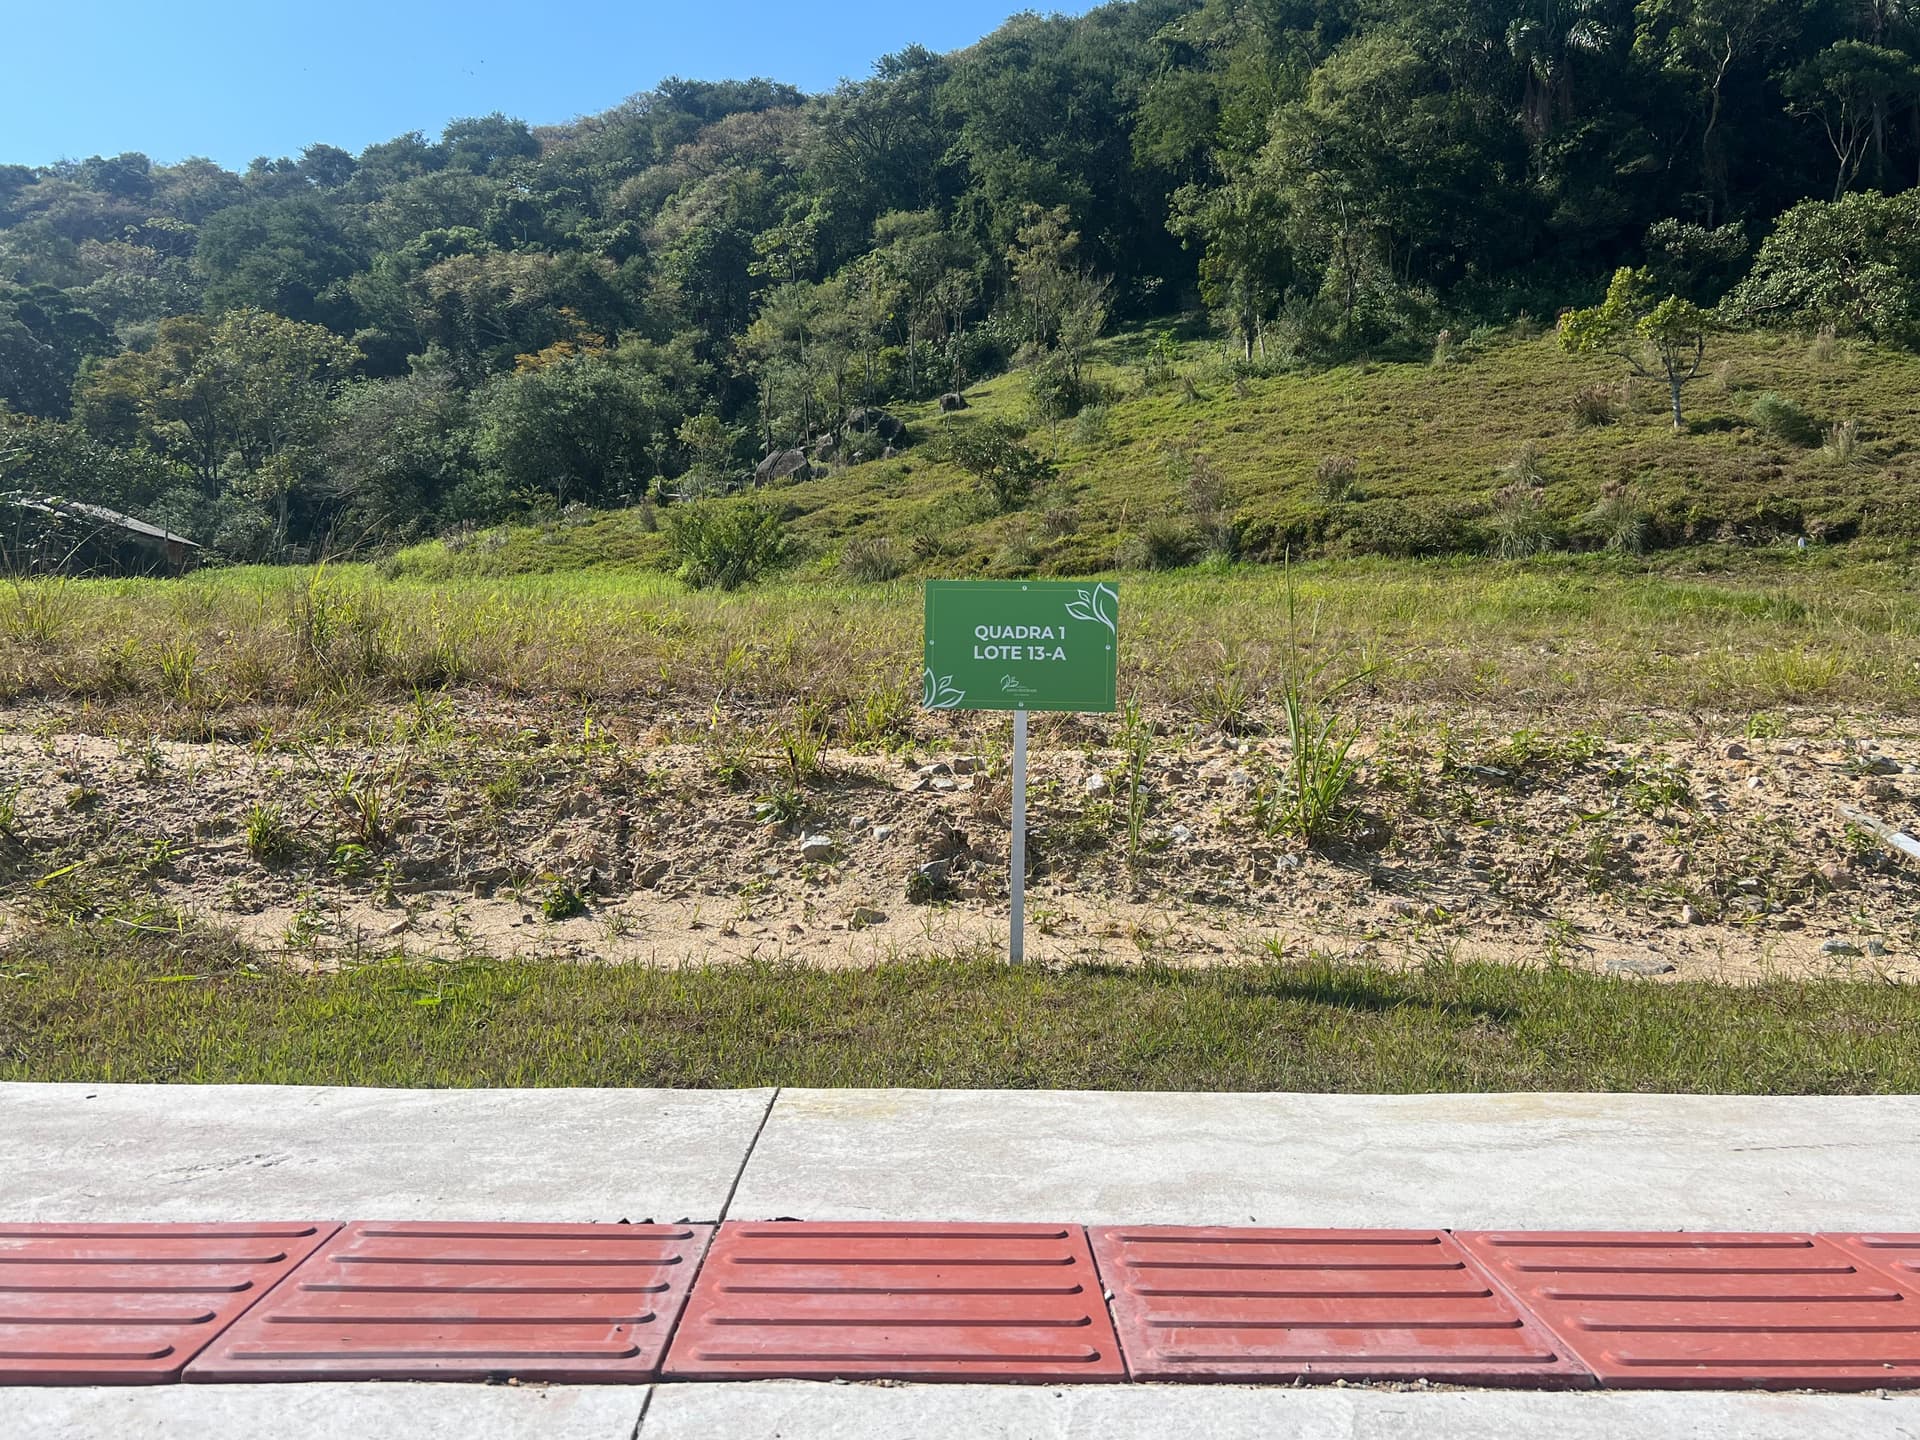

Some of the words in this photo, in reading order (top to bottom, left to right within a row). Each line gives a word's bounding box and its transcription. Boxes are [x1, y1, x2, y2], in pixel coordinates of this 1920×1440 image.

[974, 625, 1054, 641] QUADRA
[1058, 626, 1065, 640] 1
[974, 645, 1022, 660] LOTE
[1027, 646, 1067, 661] 13-A
